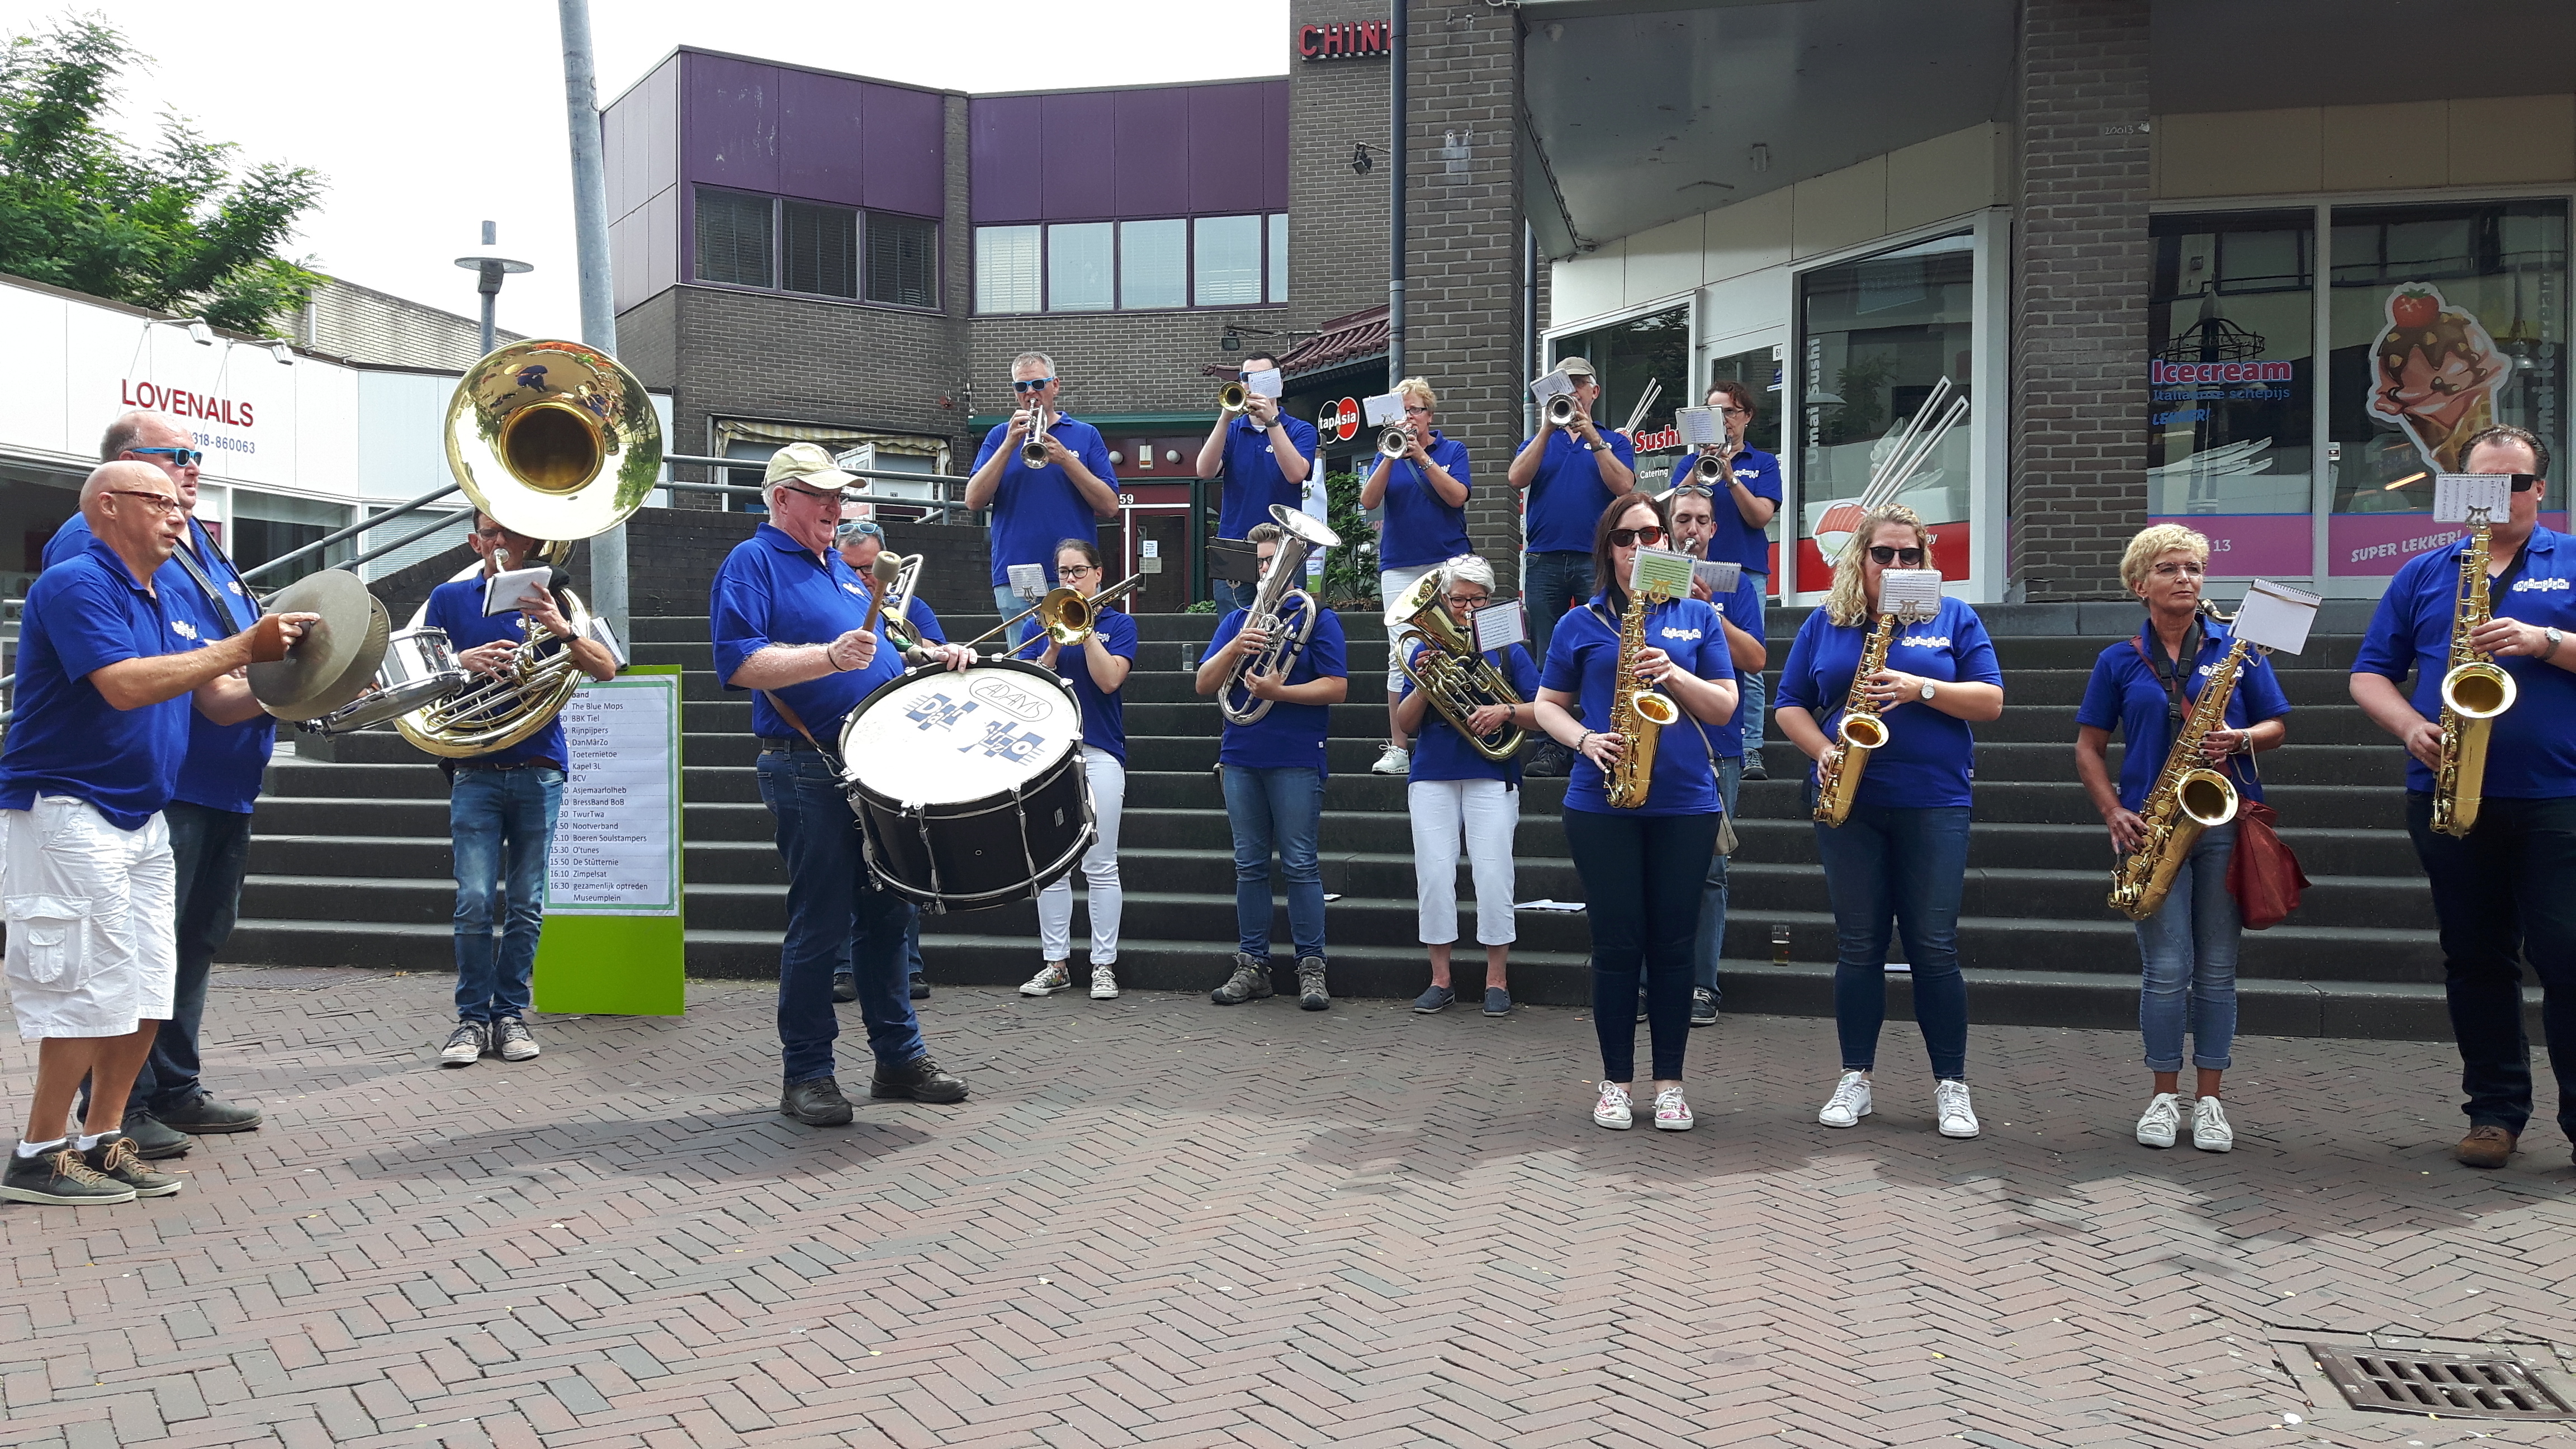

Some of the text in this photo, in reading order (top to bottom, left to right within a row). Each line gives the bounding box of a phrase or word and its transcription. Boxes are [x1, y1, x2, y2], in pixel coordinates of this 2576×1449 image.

[1775, 348, 1782, 357] 61
[2152, 359, 2292, 384] Icecream
[2229, 386, 2290, 401] schepijs
[122, 378, 254, 427] LOVENAILS
[1806, 338, 1820, 465] Umai Sushi
[1319, 410, 1356, 430] tapAsia
[1640, 468, 1669, 479] Catering
[1119, 494, 1134, 504] 59
[2351, 529, 2462, 562] SUPER LEKKER!
[974, 684, 1046, 718] ADAMS
[572, 763, 591, 771] Kapel
[572, 787, 627, 795] Asjemaarlolheb
[599, 834, 647, 843] Soulstampers
[572, 870, 607, 879] Zimpelsat
[573, 882, 614, 891] gezamenlijk
[616, 883, 648, 891] optreden
